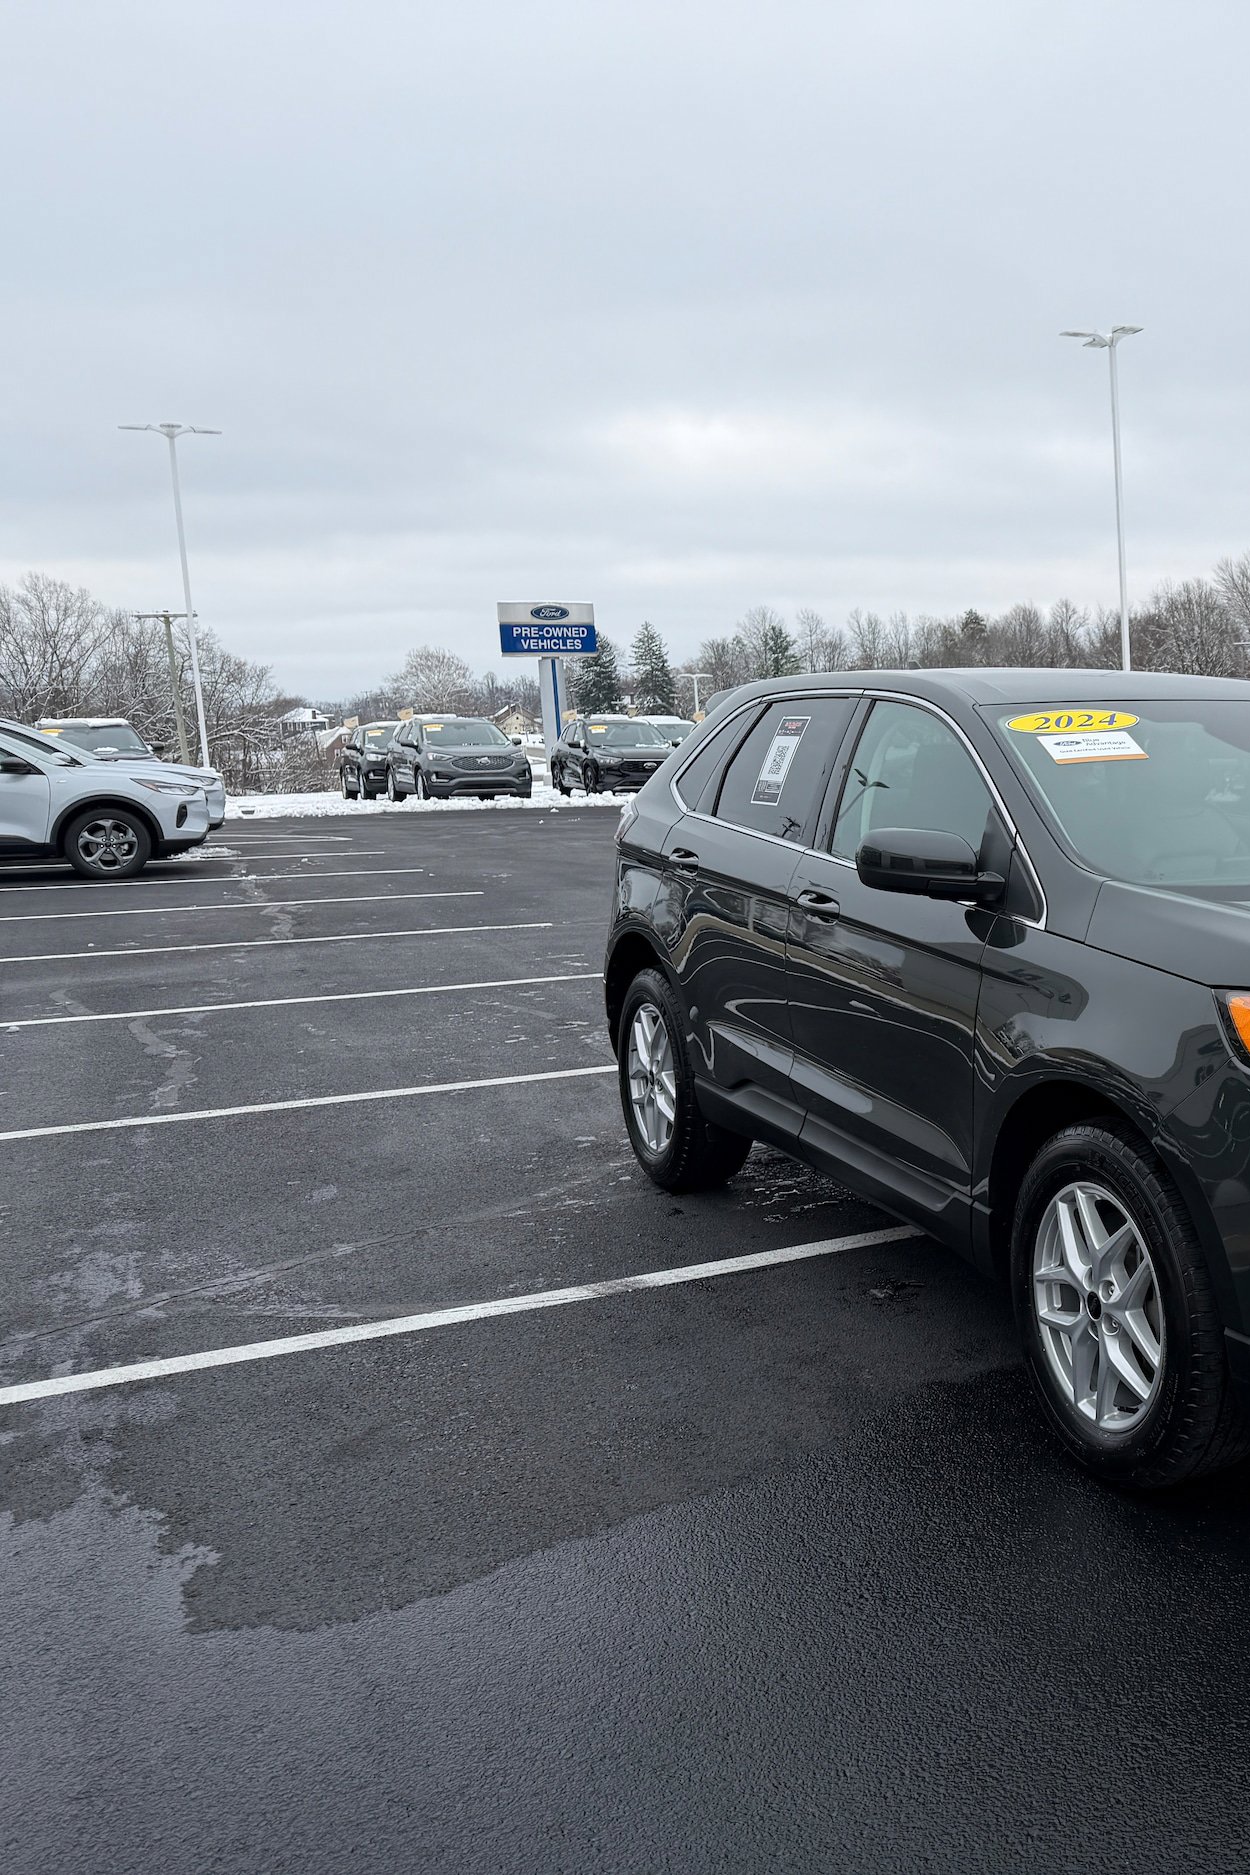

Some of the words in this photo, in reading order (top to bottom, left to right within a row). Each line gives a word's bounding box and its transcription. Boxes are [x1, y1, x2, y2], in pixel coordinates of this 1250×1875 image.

[539, 607, 562, 617] Ford
[512, 626, 588, 638] PRE-OWNED
[520, 639, 583, 650] VEHICLES
[1033, 712, 1118, 731] 2024
